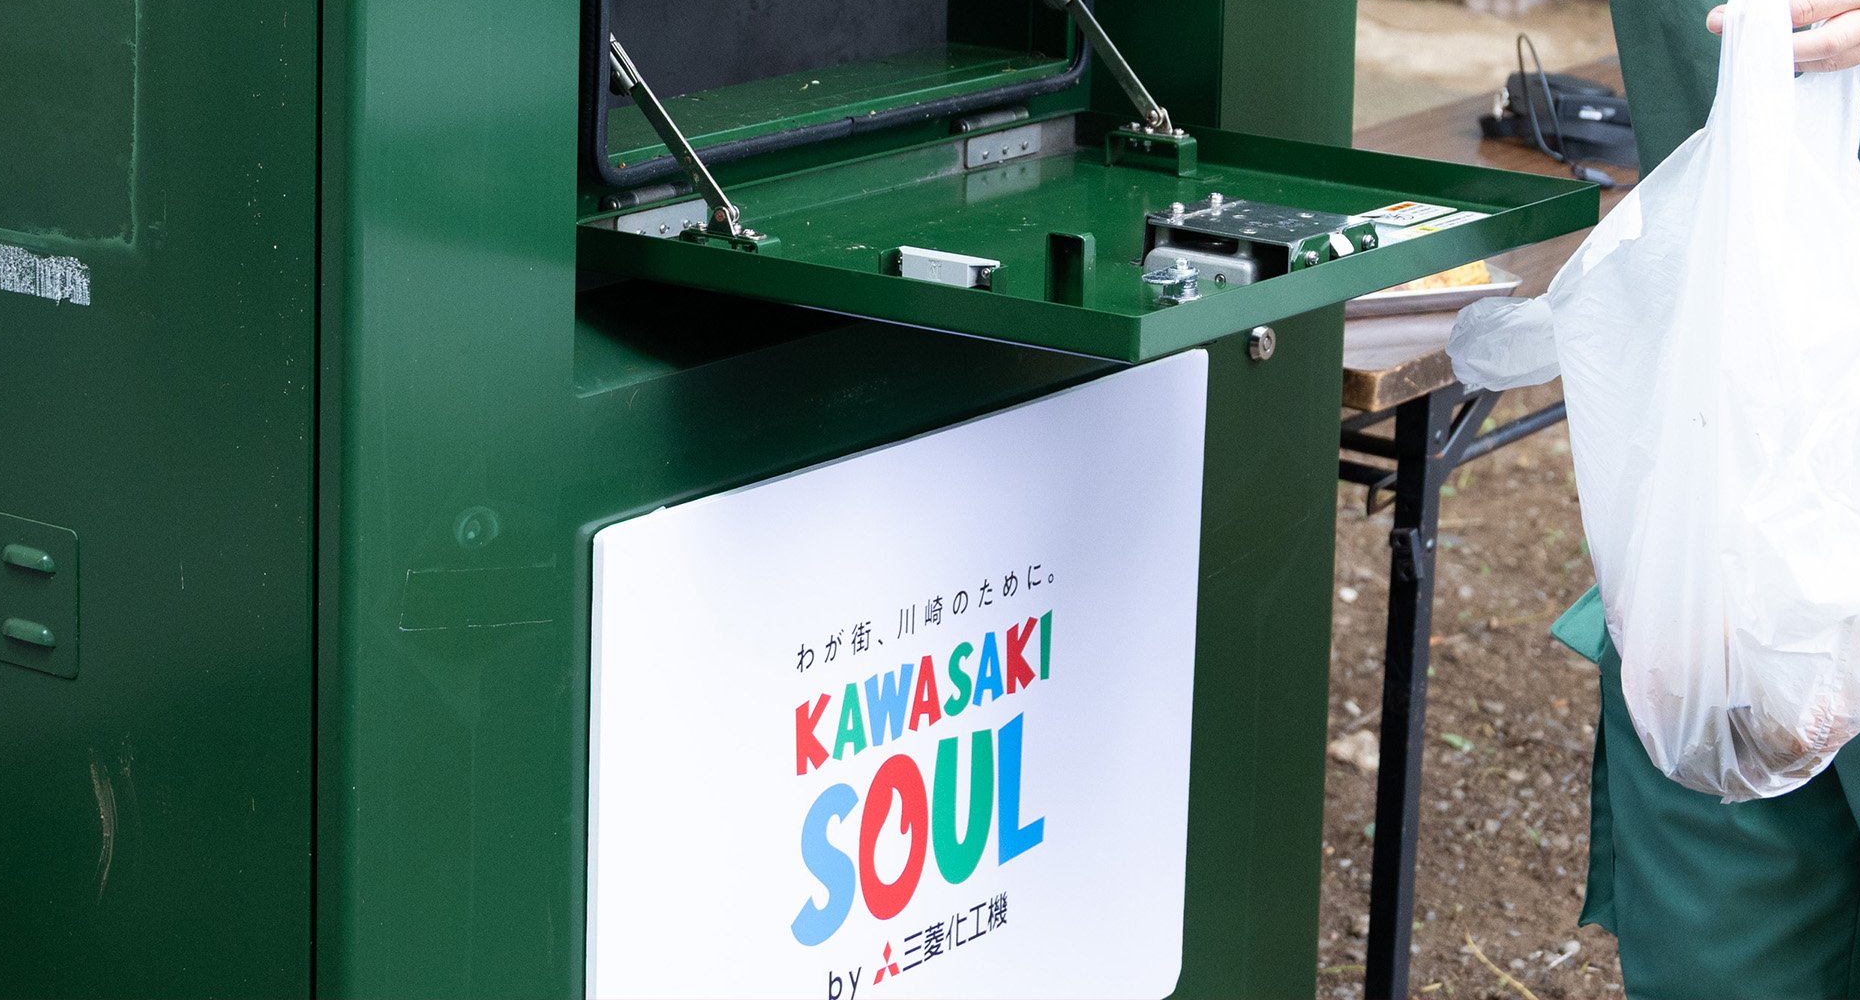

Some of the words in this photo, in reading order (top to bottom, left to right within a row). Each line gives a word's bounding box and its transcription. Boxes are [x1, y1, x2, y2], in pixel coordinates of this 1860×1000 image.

[796, 564, 1055, 673] わが街、川崎のために。
[795, 609, 1053, 776] KAWASAKI
[790, 711, 1046, 947] SOUL
[828, 966, 862, 1000] by
[902, 891, 1009, 972] 三菱化工機
